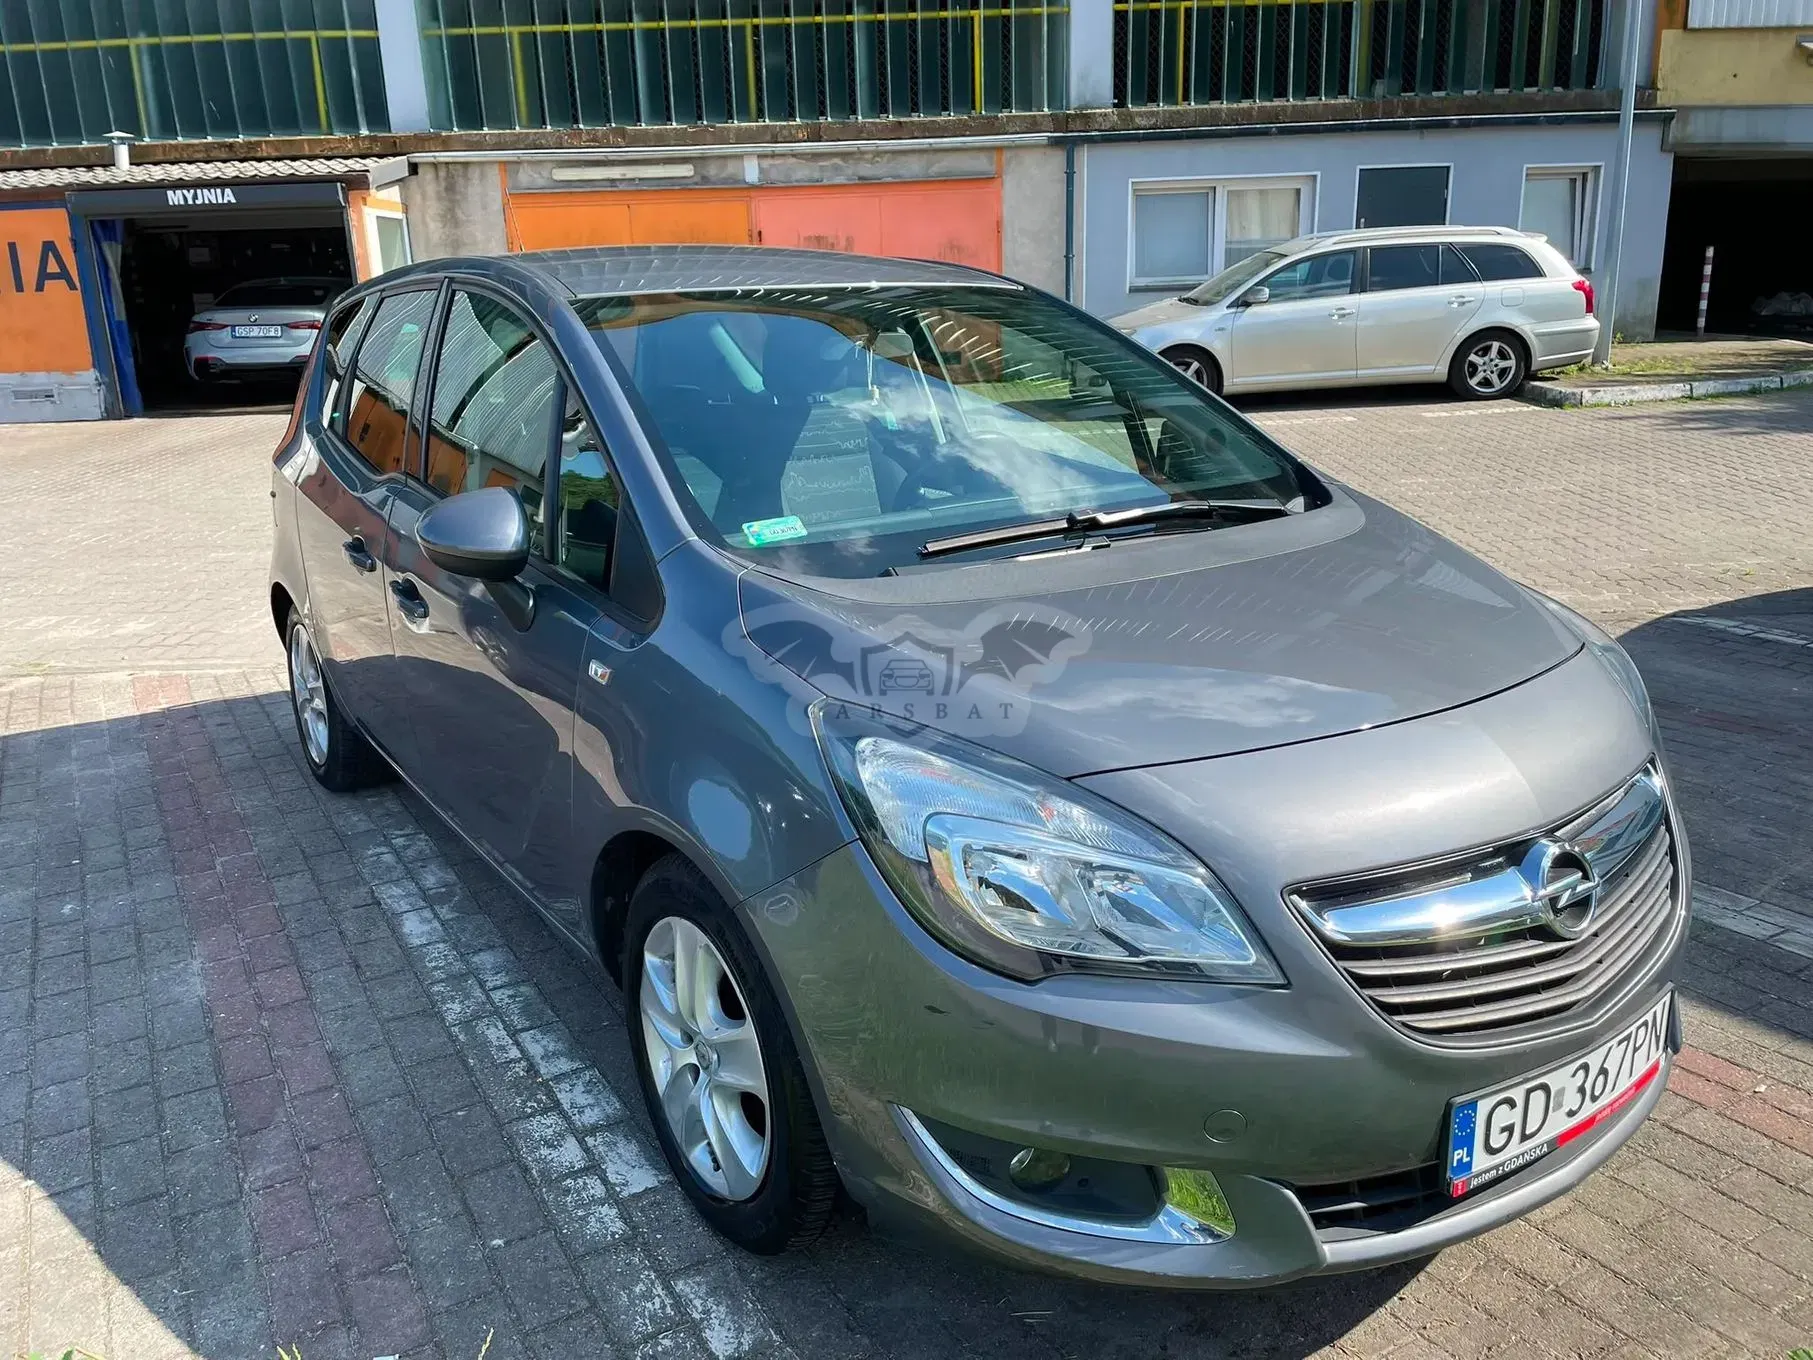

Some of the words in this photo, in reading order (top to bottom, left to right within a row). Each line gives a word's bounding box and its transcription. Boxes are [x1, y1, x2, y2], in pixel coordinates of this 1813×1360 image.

[166, 188, 237, 206] MYJNIA
[0, 240, 79, 293] IA
[237, 327, 254, 336] GSP
[1484, 1082, 1553, 1156] GD
[1565, 1001, 1666, 1118] 367PN
[1453, 1147, 1471, 1167] PL
